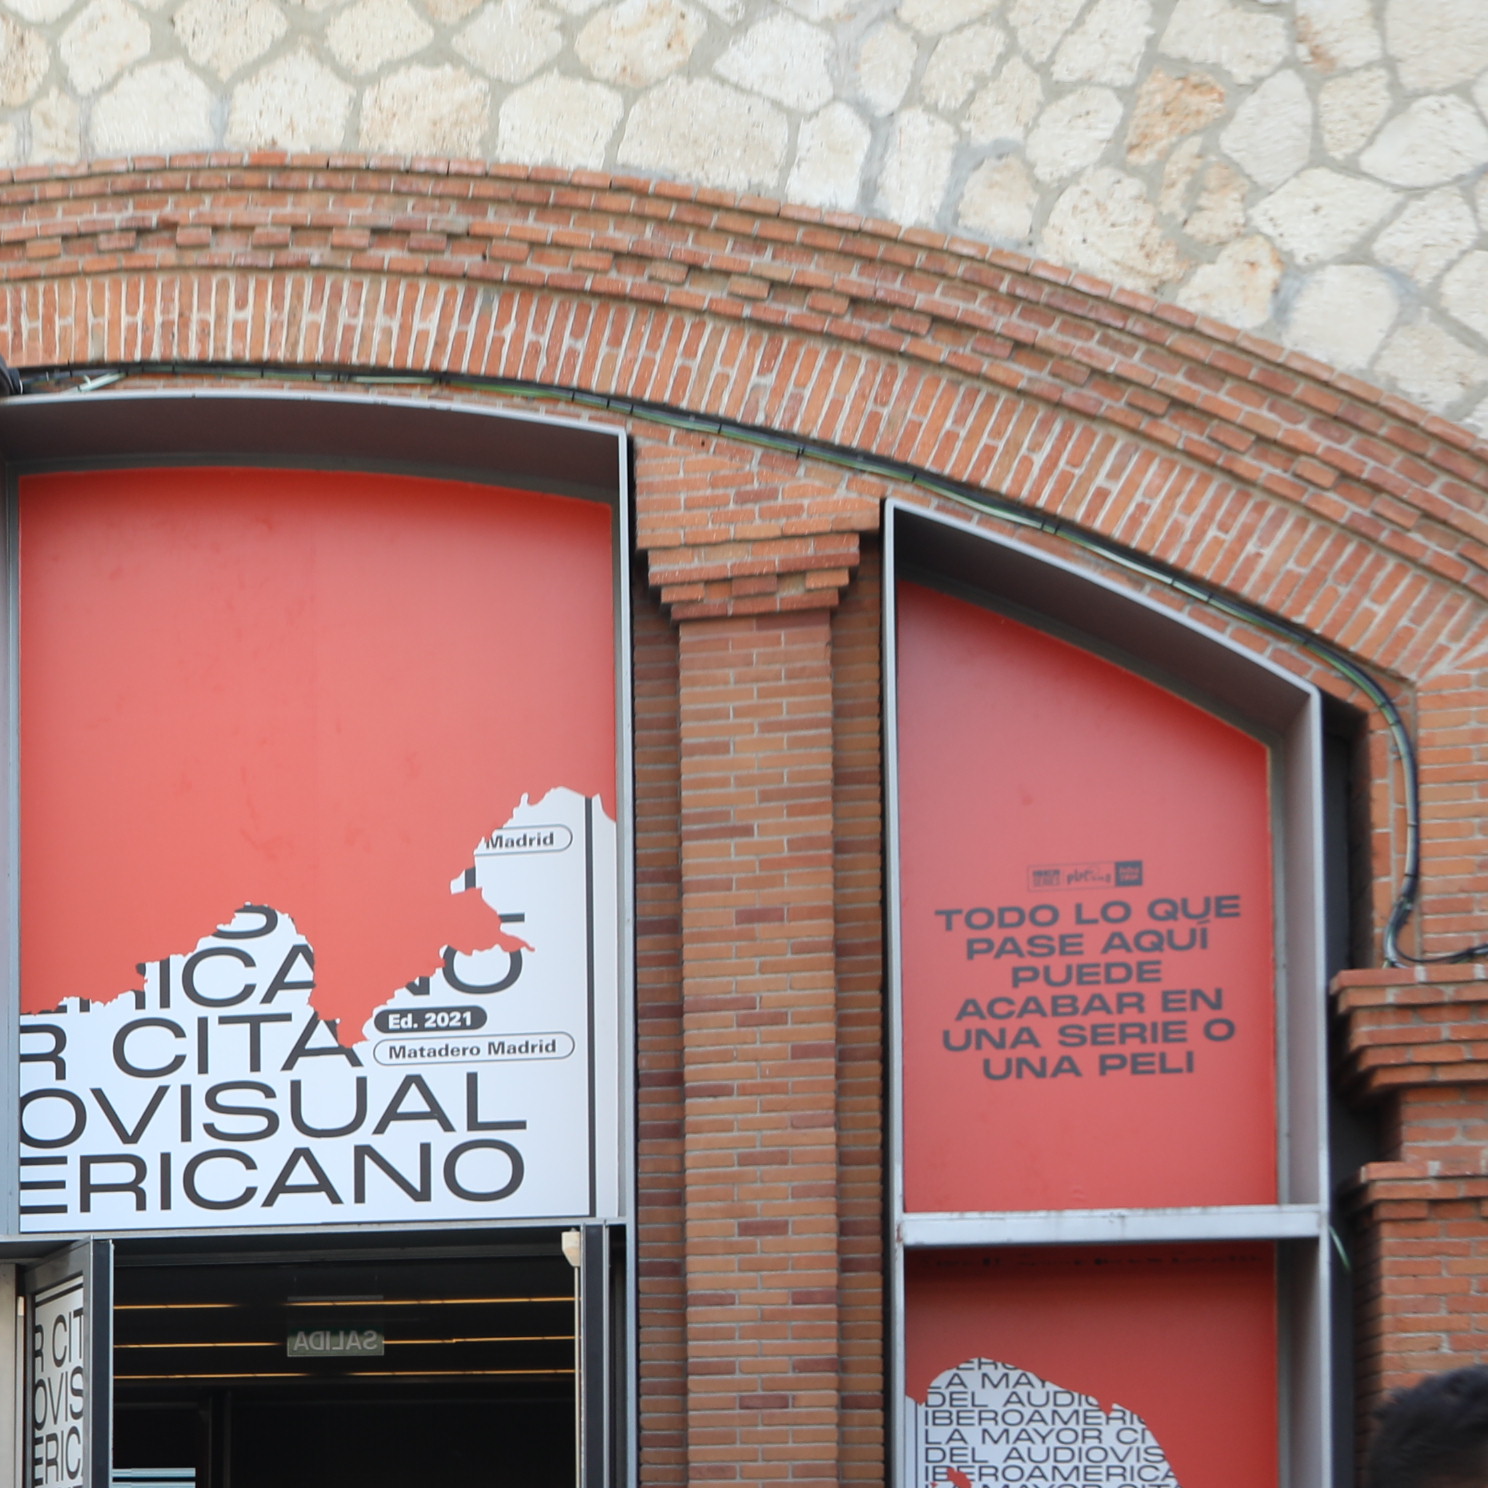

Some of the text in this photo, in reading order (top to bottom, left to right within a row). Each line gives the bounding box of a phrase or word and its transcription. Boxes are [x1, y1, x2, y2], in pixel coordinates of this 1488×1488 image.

[485, 831, 555, 850] Madrid
[934, 895, 1241, 931] TODO LO QUE
[966, 920, 1209, 961] PASE AQUÍ
[1011, 960, 1162, 988] PUEDE
[955, 987, 1224, 1021] ACABAR EN
[388, 1011, 473, 1030] Ed. 2021
[942, 1017, 1236, 1052] UNA SERIE O
[112, 1013, 363, 1079] CITA
[389, 1039, 556, 1061] Matadero Madrid
[983, 1051, 1195, 1081] UNA PELI
[924, 1390, 990, 1407] DEL
[924, 1428, 968, 1445] LA
[981, 1428, 1103, 1445] MAYOR
[924, 1446, 990, 1463] DEL
